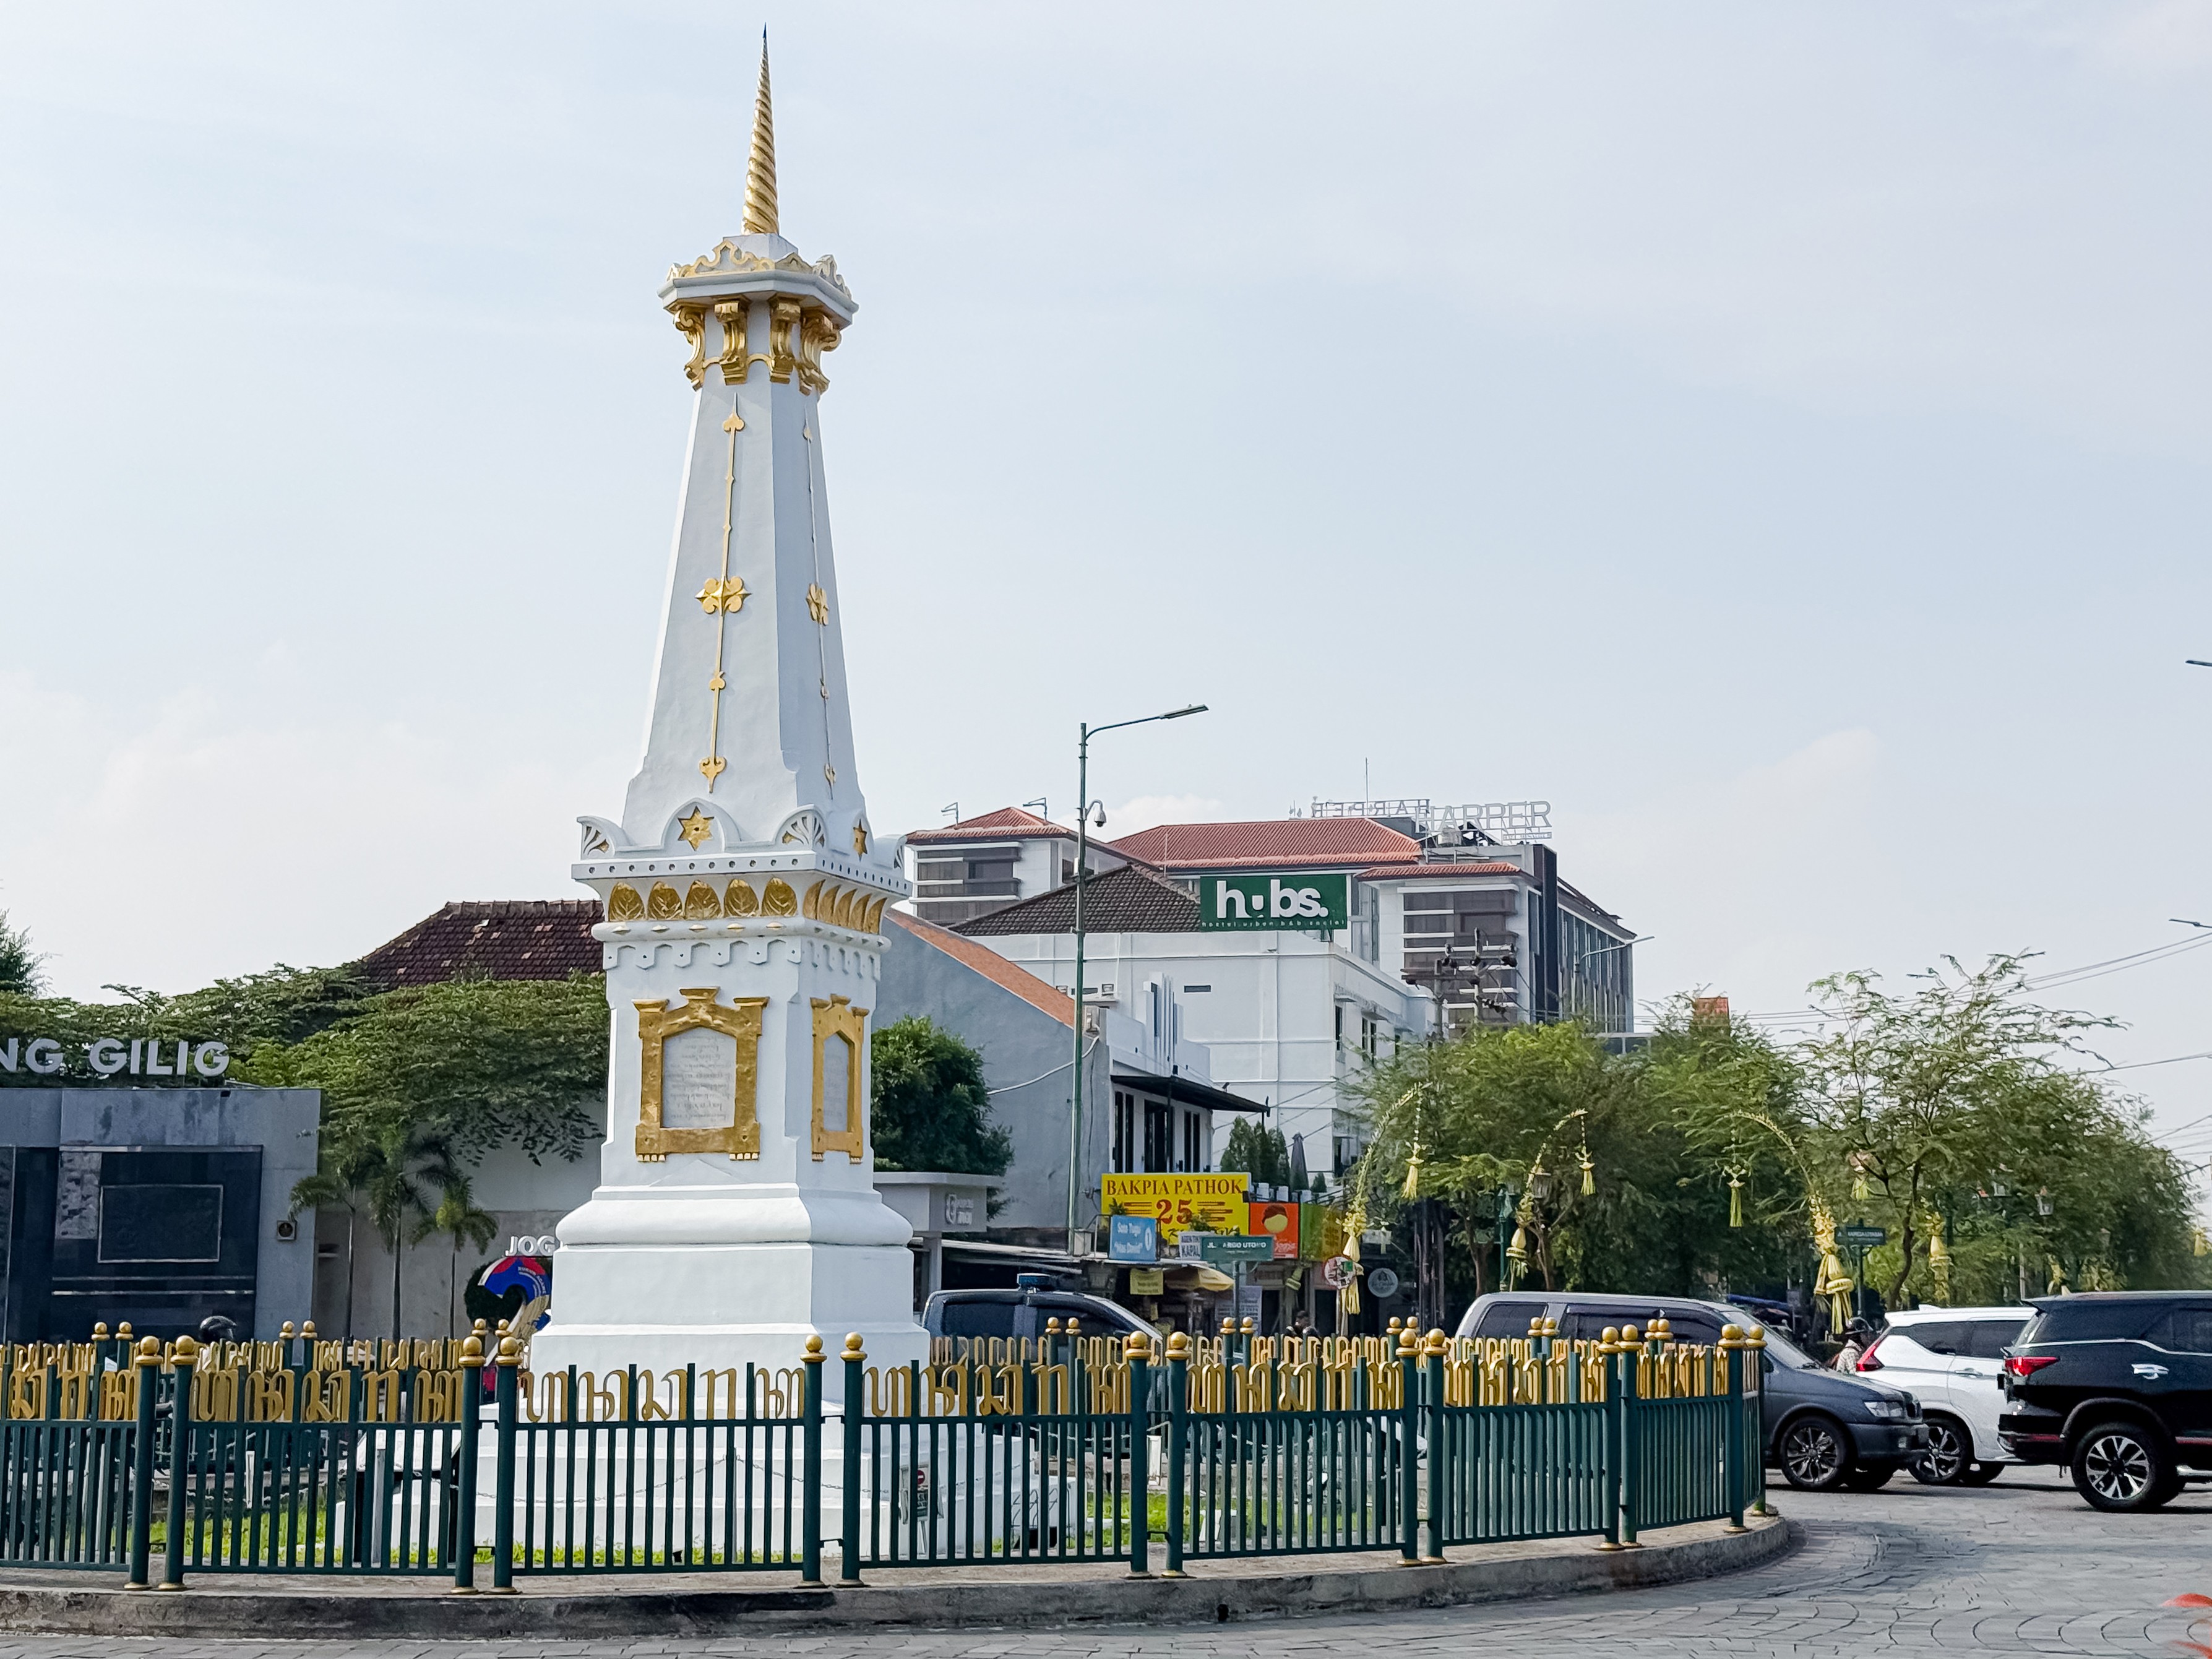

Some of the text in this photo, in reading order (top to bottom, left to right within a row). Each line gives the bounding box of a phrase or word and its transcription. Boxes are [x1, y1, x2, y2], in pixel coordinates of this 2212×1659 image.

[1415, 801, 1552, 834] HARPER
[90, 1038, 230, 1077] GILIG
[1106, 1178, 1243, 1196] BAKPIA PATHOK
[1155, 1198, 1193, 1225] 25
